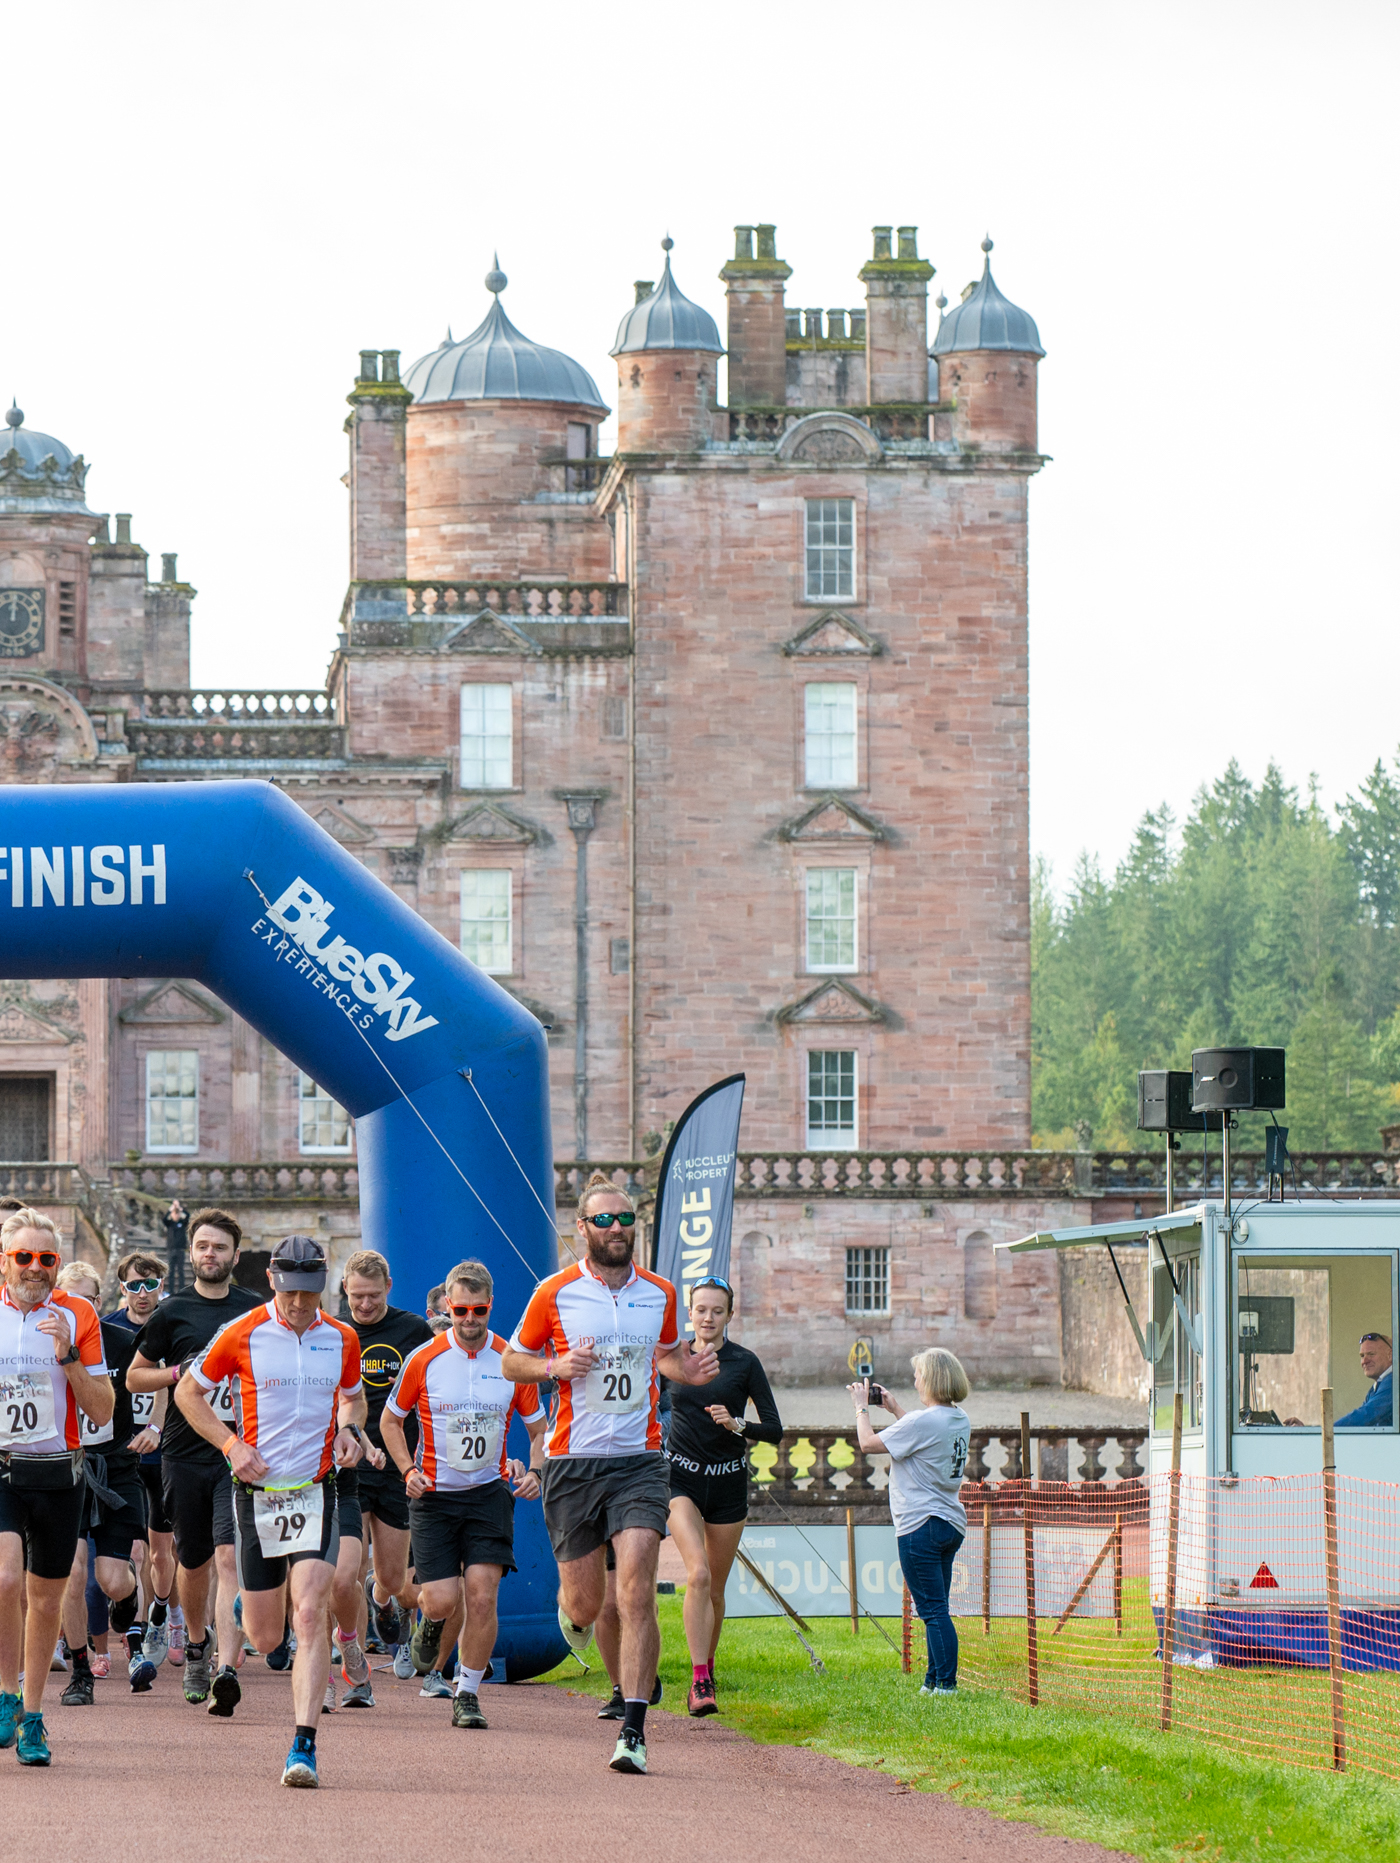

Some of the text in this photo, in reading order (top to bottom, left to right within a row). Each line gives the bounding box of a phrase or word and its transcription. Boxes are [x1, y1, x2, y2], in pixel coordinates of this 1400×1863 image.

[265, 876, 440, 1042] BlueSky
[251, 918, 374, 1029] EXPERIENCES
[579, 1332, 654, 1347] jmarchitects
[264, 1375, 334, 1389] jmarchitects
[603, 1373, 632, 1401] 20
[133, 1394, 154, 1416] 57
[439, 1401, 503, 1412] jmarchitects
[6, 1402, 38, 1434] 20
[461, 1435, 487, 1460] 20
[672, 1453, 700, 1473] PRO
[704, 1460, 740, 1476] NIKE
[274, 1512, 306, 1542] 29
